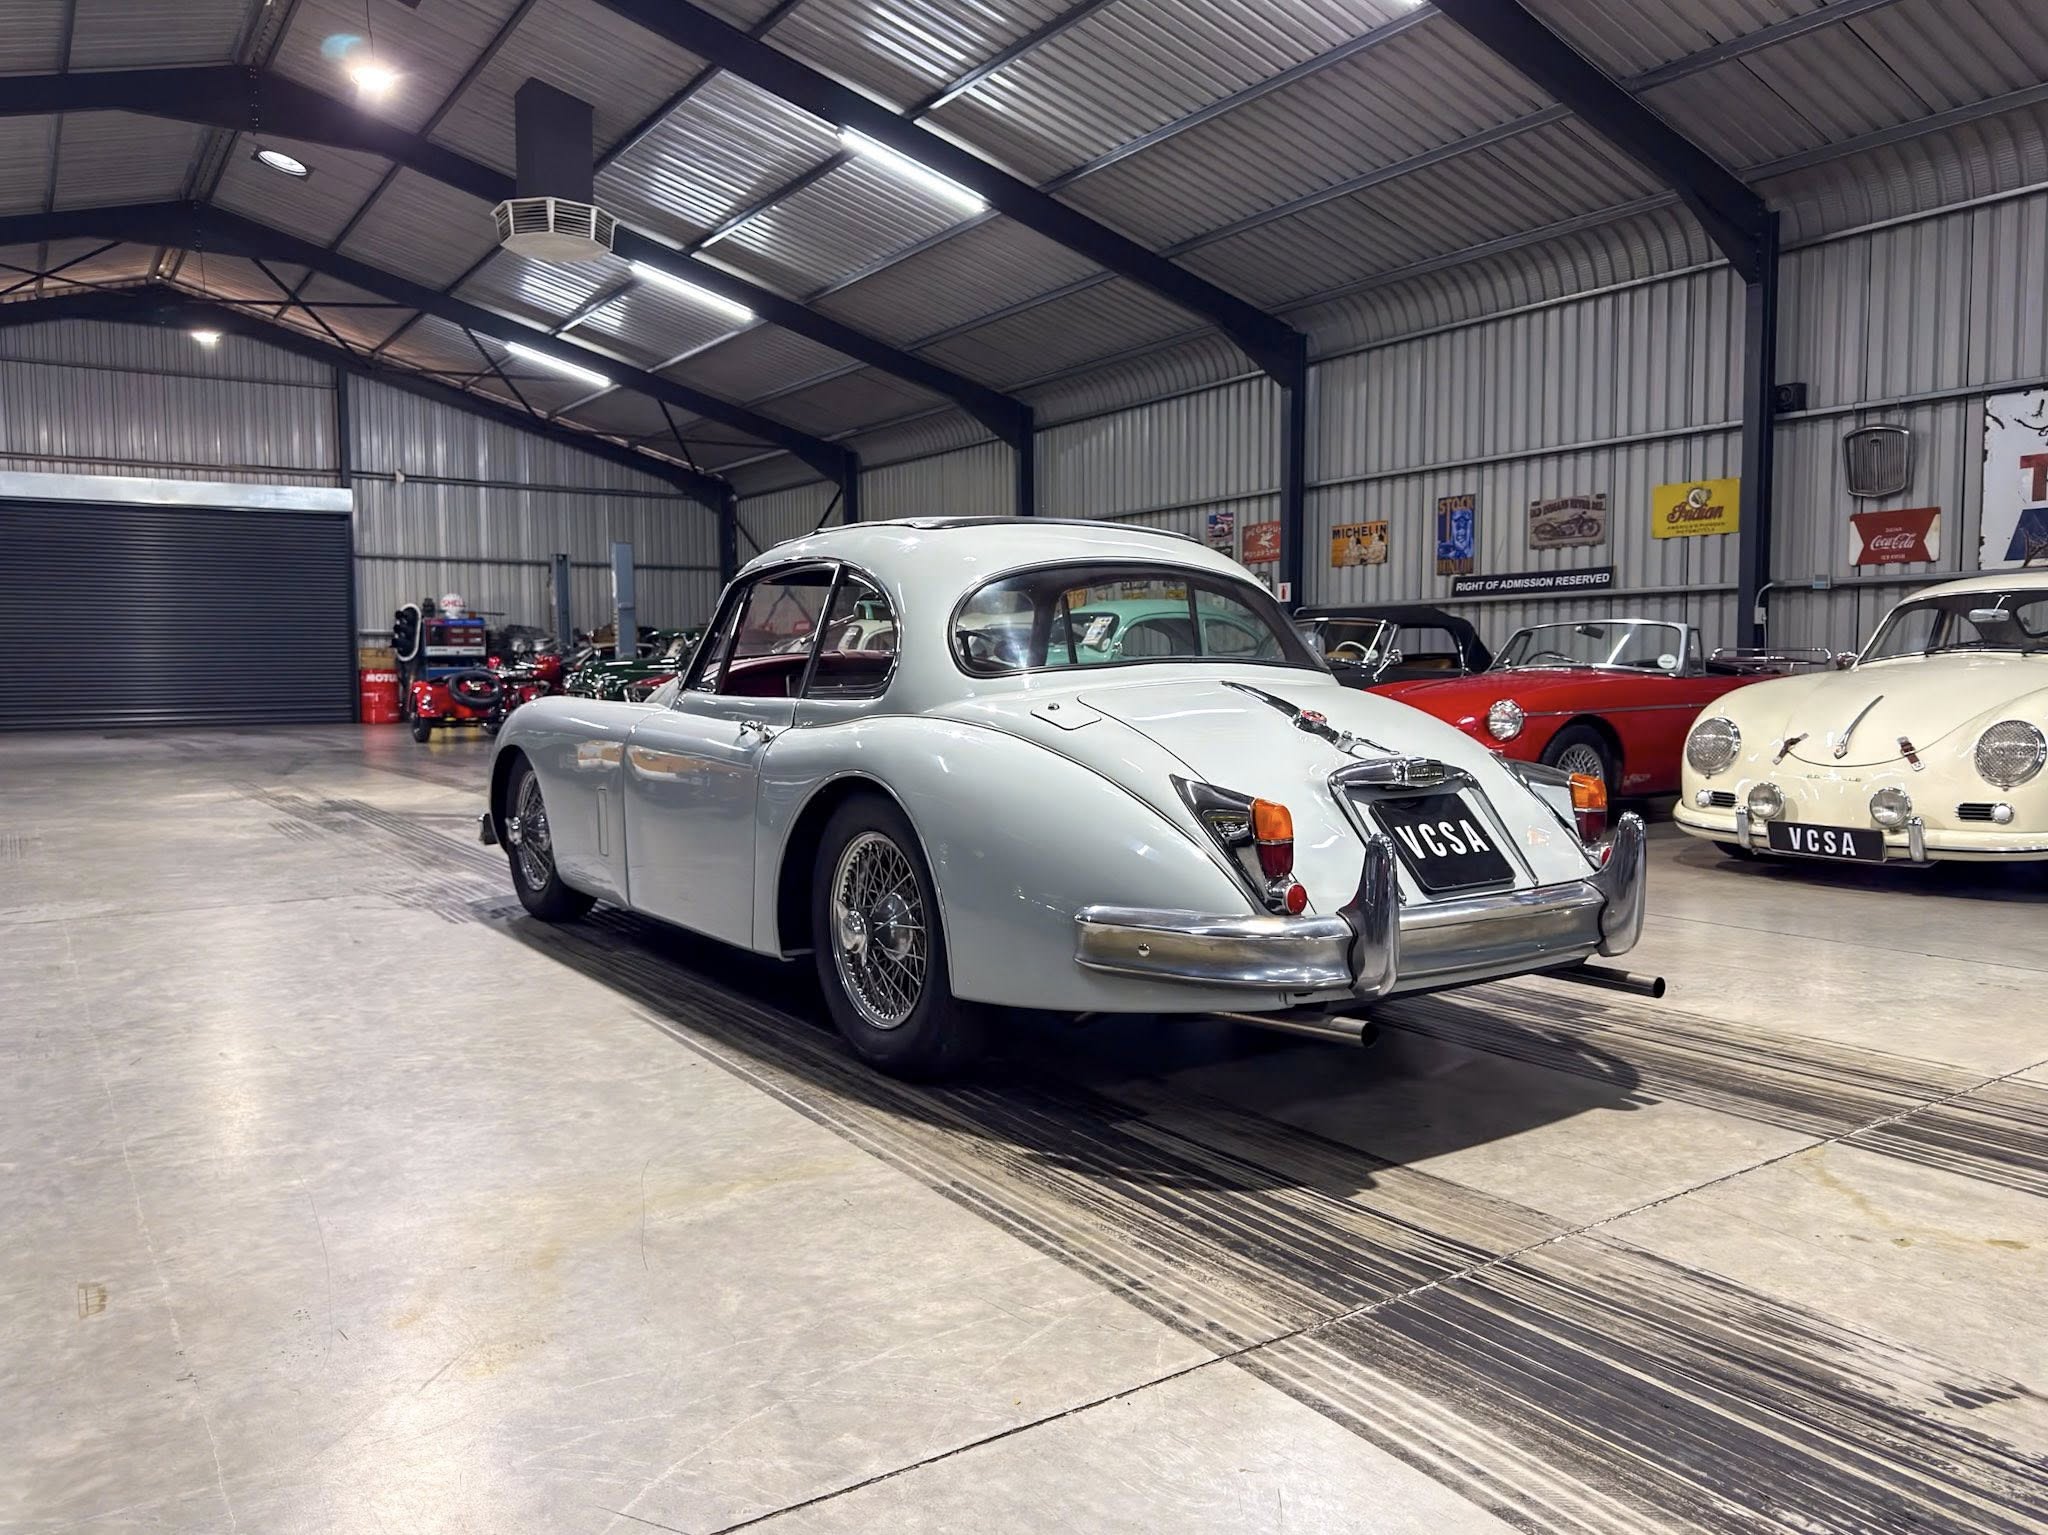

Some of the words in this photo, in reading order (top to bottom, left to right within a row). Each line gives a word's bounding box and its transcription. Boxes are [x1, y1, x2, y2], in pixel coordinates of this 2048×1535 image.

[1667, 501, 1724, 523] Indian
[1332, 524, 1387, 540] MICHELIN
[1456, 581, 1484, 592] RIGHT
[1486, 581, 1499, 590] OF
[1500, 577, 1553, 589] ADMISSION
[1555, 573, 1610, 586] RESERVED
[366, 673, 398, 682] MOTU
[1394, 820, 1490, 859] VCSA
[1788, 827, 1857, 856] VCSA
